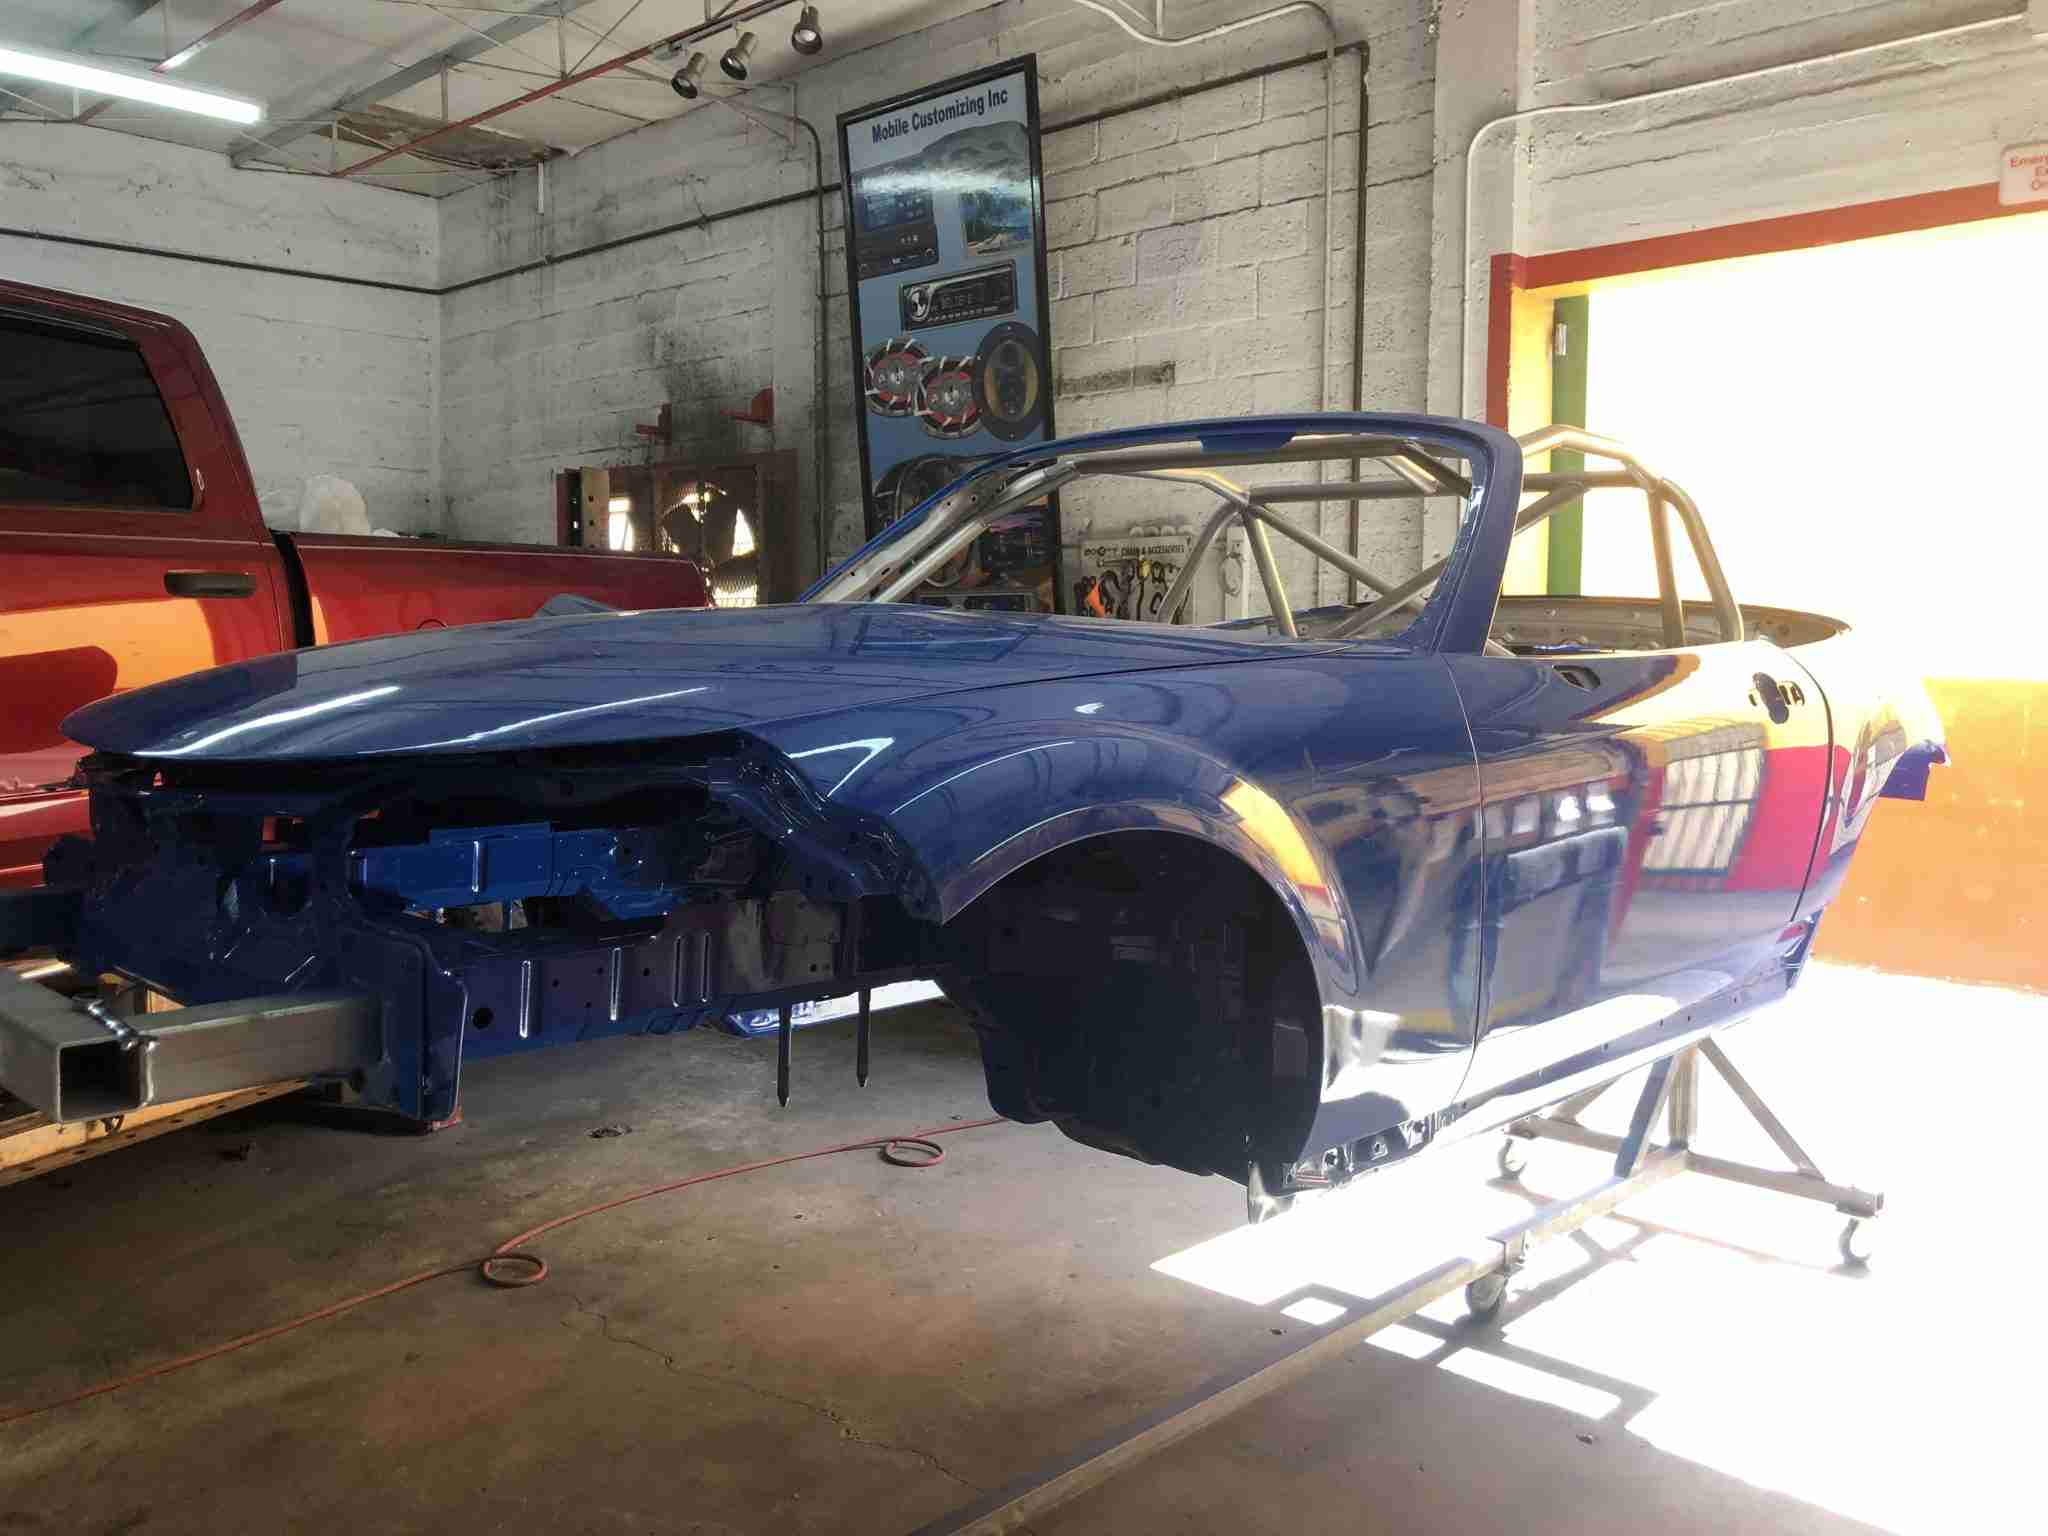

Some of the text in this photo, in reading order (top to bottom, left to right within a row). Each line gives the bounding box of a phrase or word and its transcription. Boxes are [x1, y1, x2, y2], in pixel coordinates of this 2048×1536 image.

[871, 89, 1009, 144] Mobile Customizing Inc
